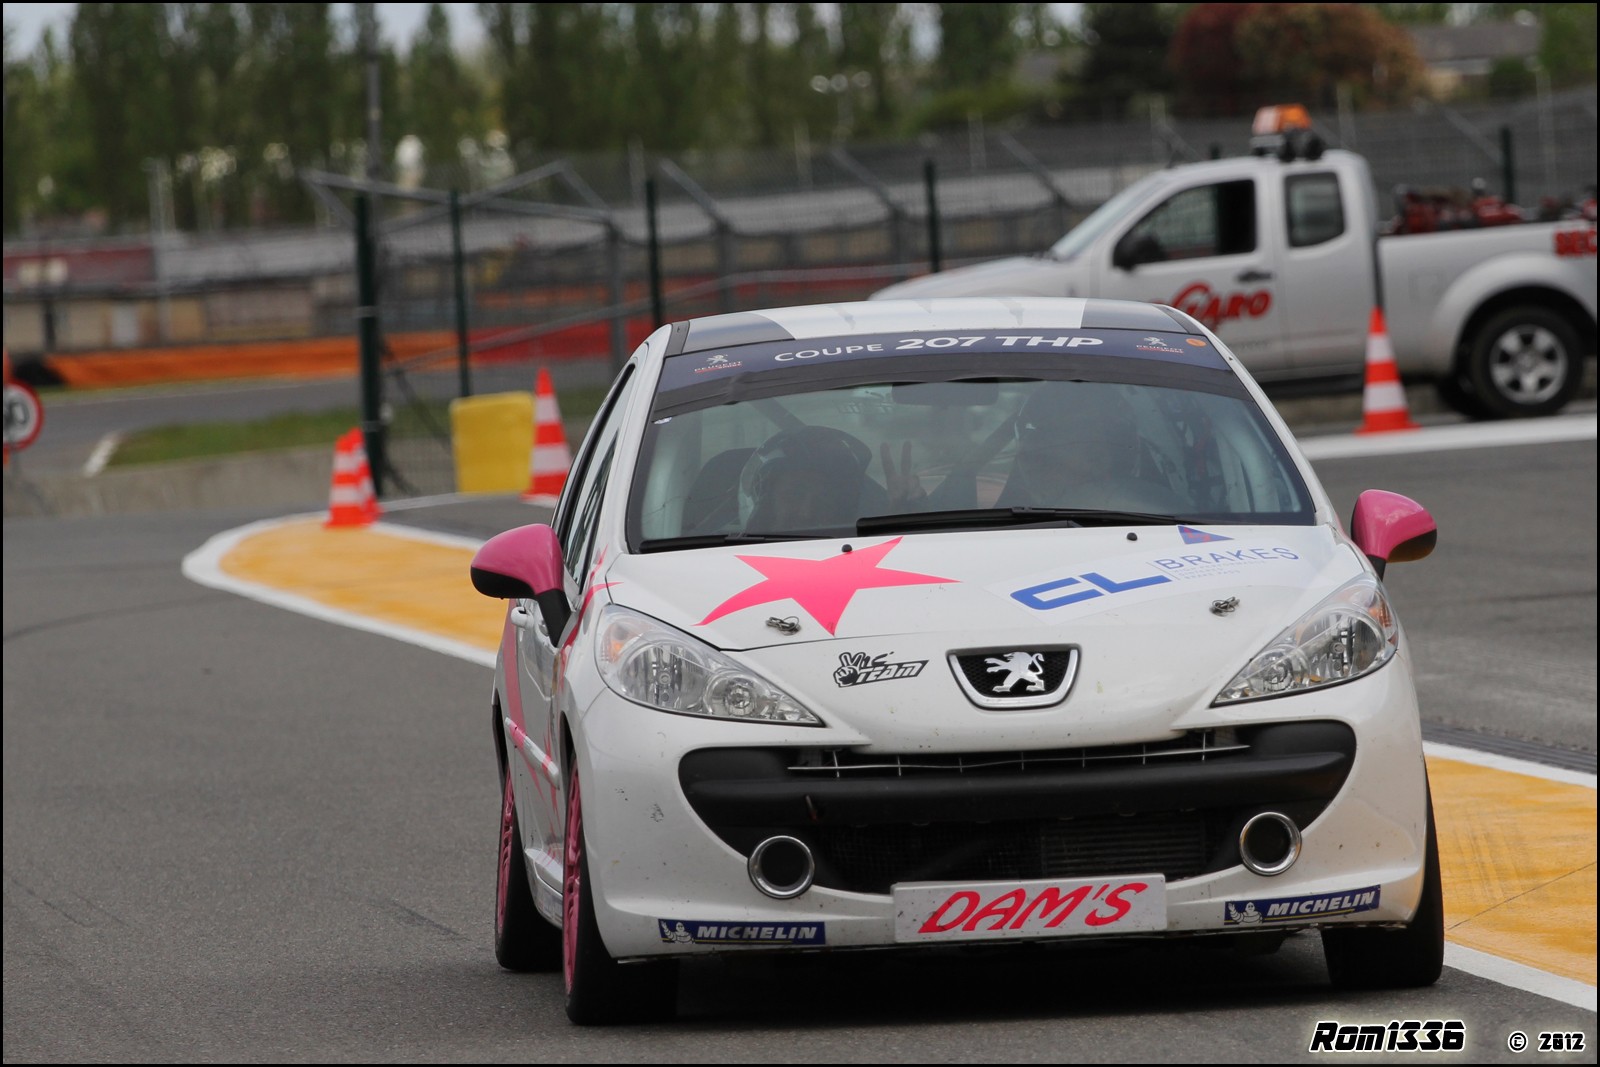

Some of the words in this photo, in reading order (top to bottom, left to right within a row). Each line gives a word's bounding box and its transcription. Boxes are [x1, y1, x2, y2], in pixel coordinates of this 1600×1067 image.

[774, 343, 884, 362] COUPE
[896, 336, 986, 350] 207
[995, 336, 1104, 348] THP
[1010, 571, 1172, 610] CL
[1154, 547, 1299, 570] BRAKES
[917, 882, 1148, 934] DAM'S
[1267, 891, 1375, 916] MICHELIN
[697, 926, 817, 939] MICHELIN
